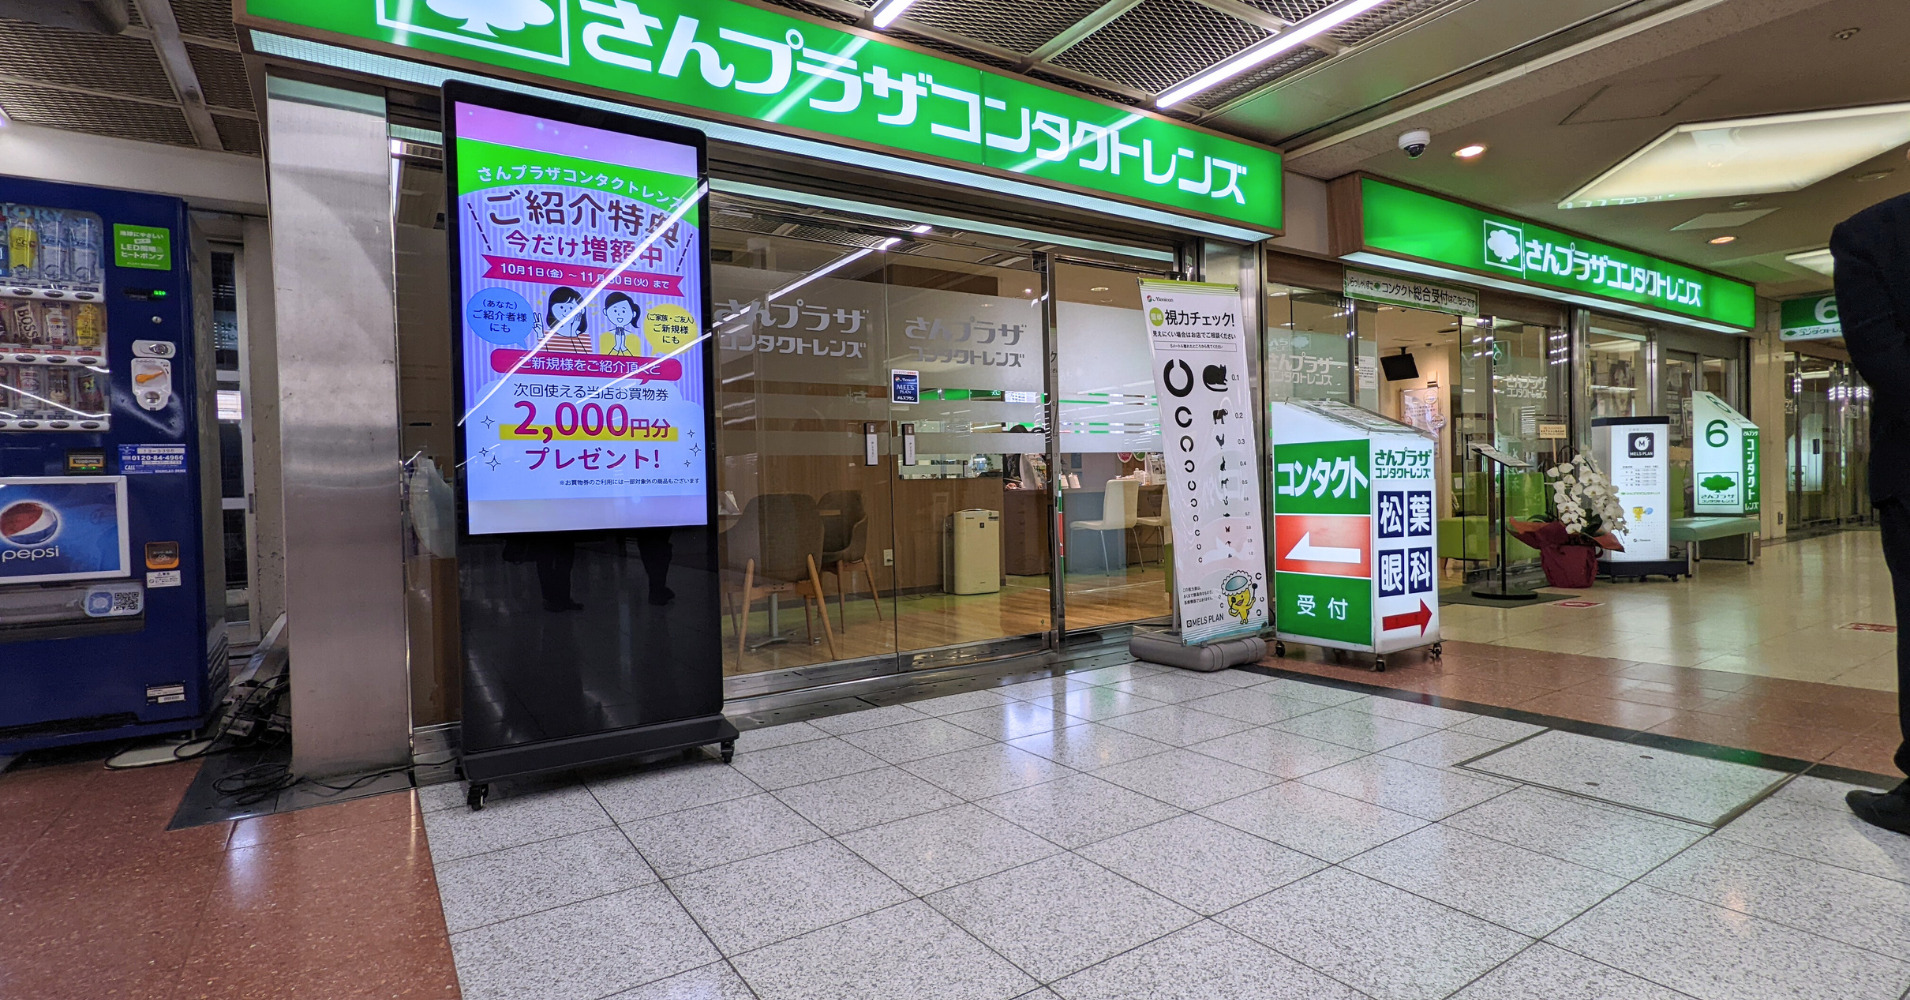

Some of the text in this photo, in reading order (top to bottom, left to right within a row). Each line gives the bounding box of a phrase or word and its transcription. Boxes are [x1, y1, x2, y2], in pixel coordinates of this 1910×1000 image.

[579, 0, 1247, 205] さんプラザコンタクトレンズ
[486, 189, 680, 248] ご紹介特典
[506, 229, 663, 268] 今だけ増額中
[500, 263, 563, 279] 10月1日(金)
[653, 279, 670, 289] まで
[1525, 239, 1702, 308] さんプラザコンタクトレンズ
[482, 299, 518, 310] (あなた)
[1382, 282, 1476, 309] コンタクト総合受付はこちらです
[472, 310, 527, 323] ご紹介者様
[713, 298, 869, 334] さんプラザ
[1164, 308, 1235, 327] 視力チェック!
[1815, 297, 1840, 324] 6
[17, 308, 39, 340] BOSS
[489, 323, 511, 334] にも
[653, 324, 690, 335] ご新規様
[905, 315, 1027, 346] さんプラザ
[1799, 328, 1843, 336] コンタクトレ
[662, 335, 680, 345] にも
[719, 334, 867, 359] コンタクトレンズ
[519, 354, 661, 376] ご新規様をご紹介頂くと
[909, 345, 1025, 368] コンタクトレンズ
[1269, 351, 1334, 374] さんプラザ
[1231, 373, 1240, 381] 0.1
[513, 382, 669, 402] 次回使える当店お買物券
[513, 401, 671, 444] 2,000円分
[1706, 419, 1729, 448] 6
[525, 446, 660, 470] プレゼント!
[1374, 447, 1432, 467] さんプラザ
[1747, 438, 1755, 500] コンタクト
[1277, 456, 1369, 499] コンタクト
[1375, 467, 1431, 479] コンタクトレンズ
[1379, 494, 1430, 535] 松葉
[1744, 501, 1759, 511] レンズ
[2, 545, 60, 563] pepsi
[1380, 550, 1431, 592] 眼科
[1192, 613, 1224, 626] MELS PLAN
[1297, 594, 1348, 621] 受付
